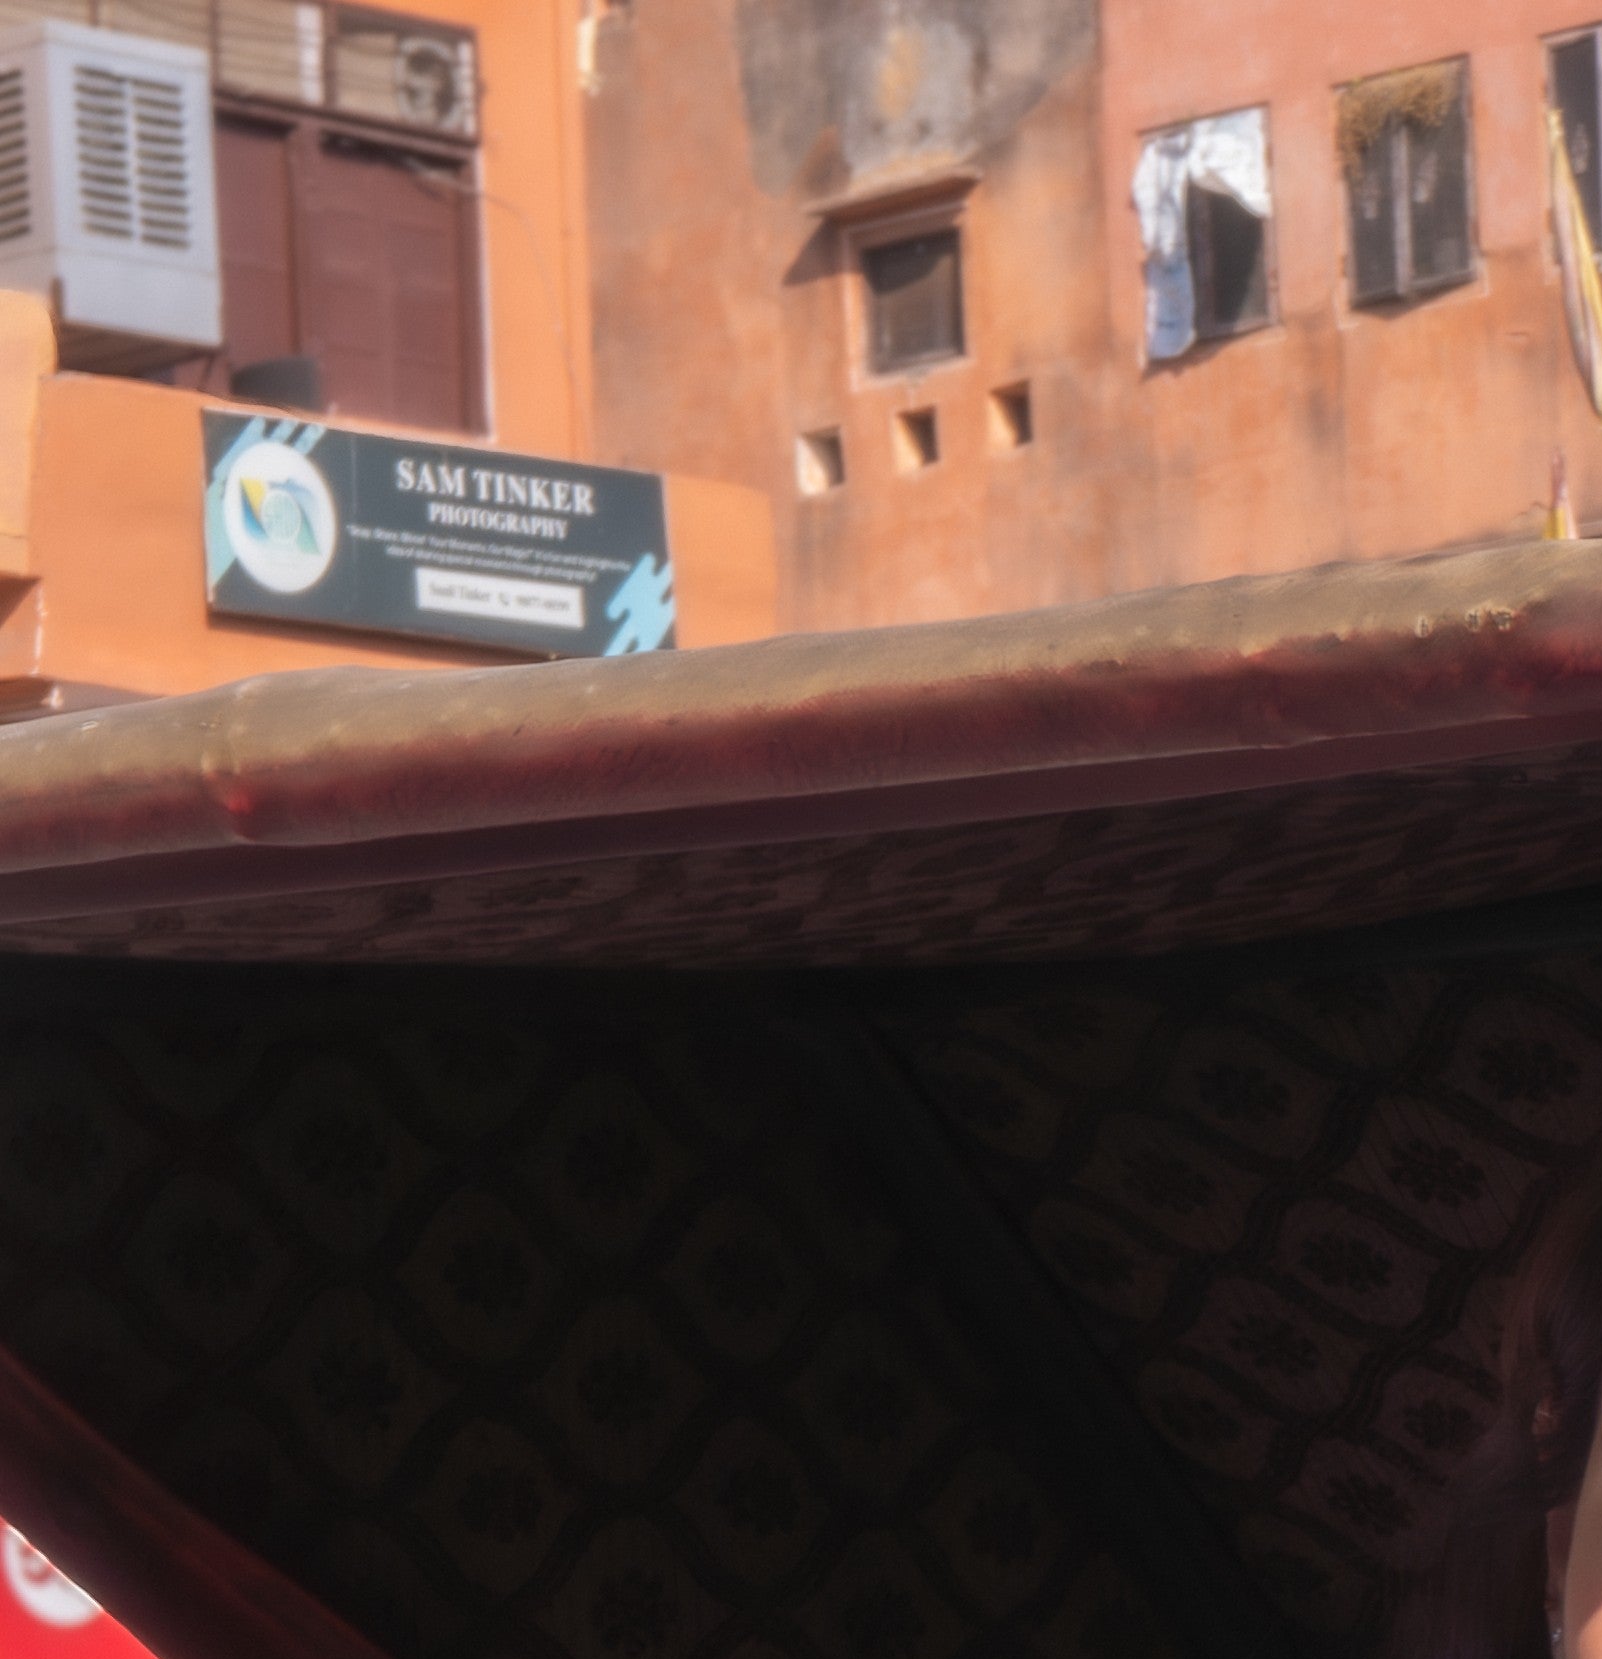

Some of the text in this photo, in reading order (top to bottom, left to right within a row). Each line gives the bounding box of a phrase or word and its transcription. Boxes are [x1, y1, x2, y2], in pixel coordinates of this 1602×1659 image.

[396, 458, 597, 516] SAM TINKER
[428, 502, 568, 540] PHOTOGRAPHY
